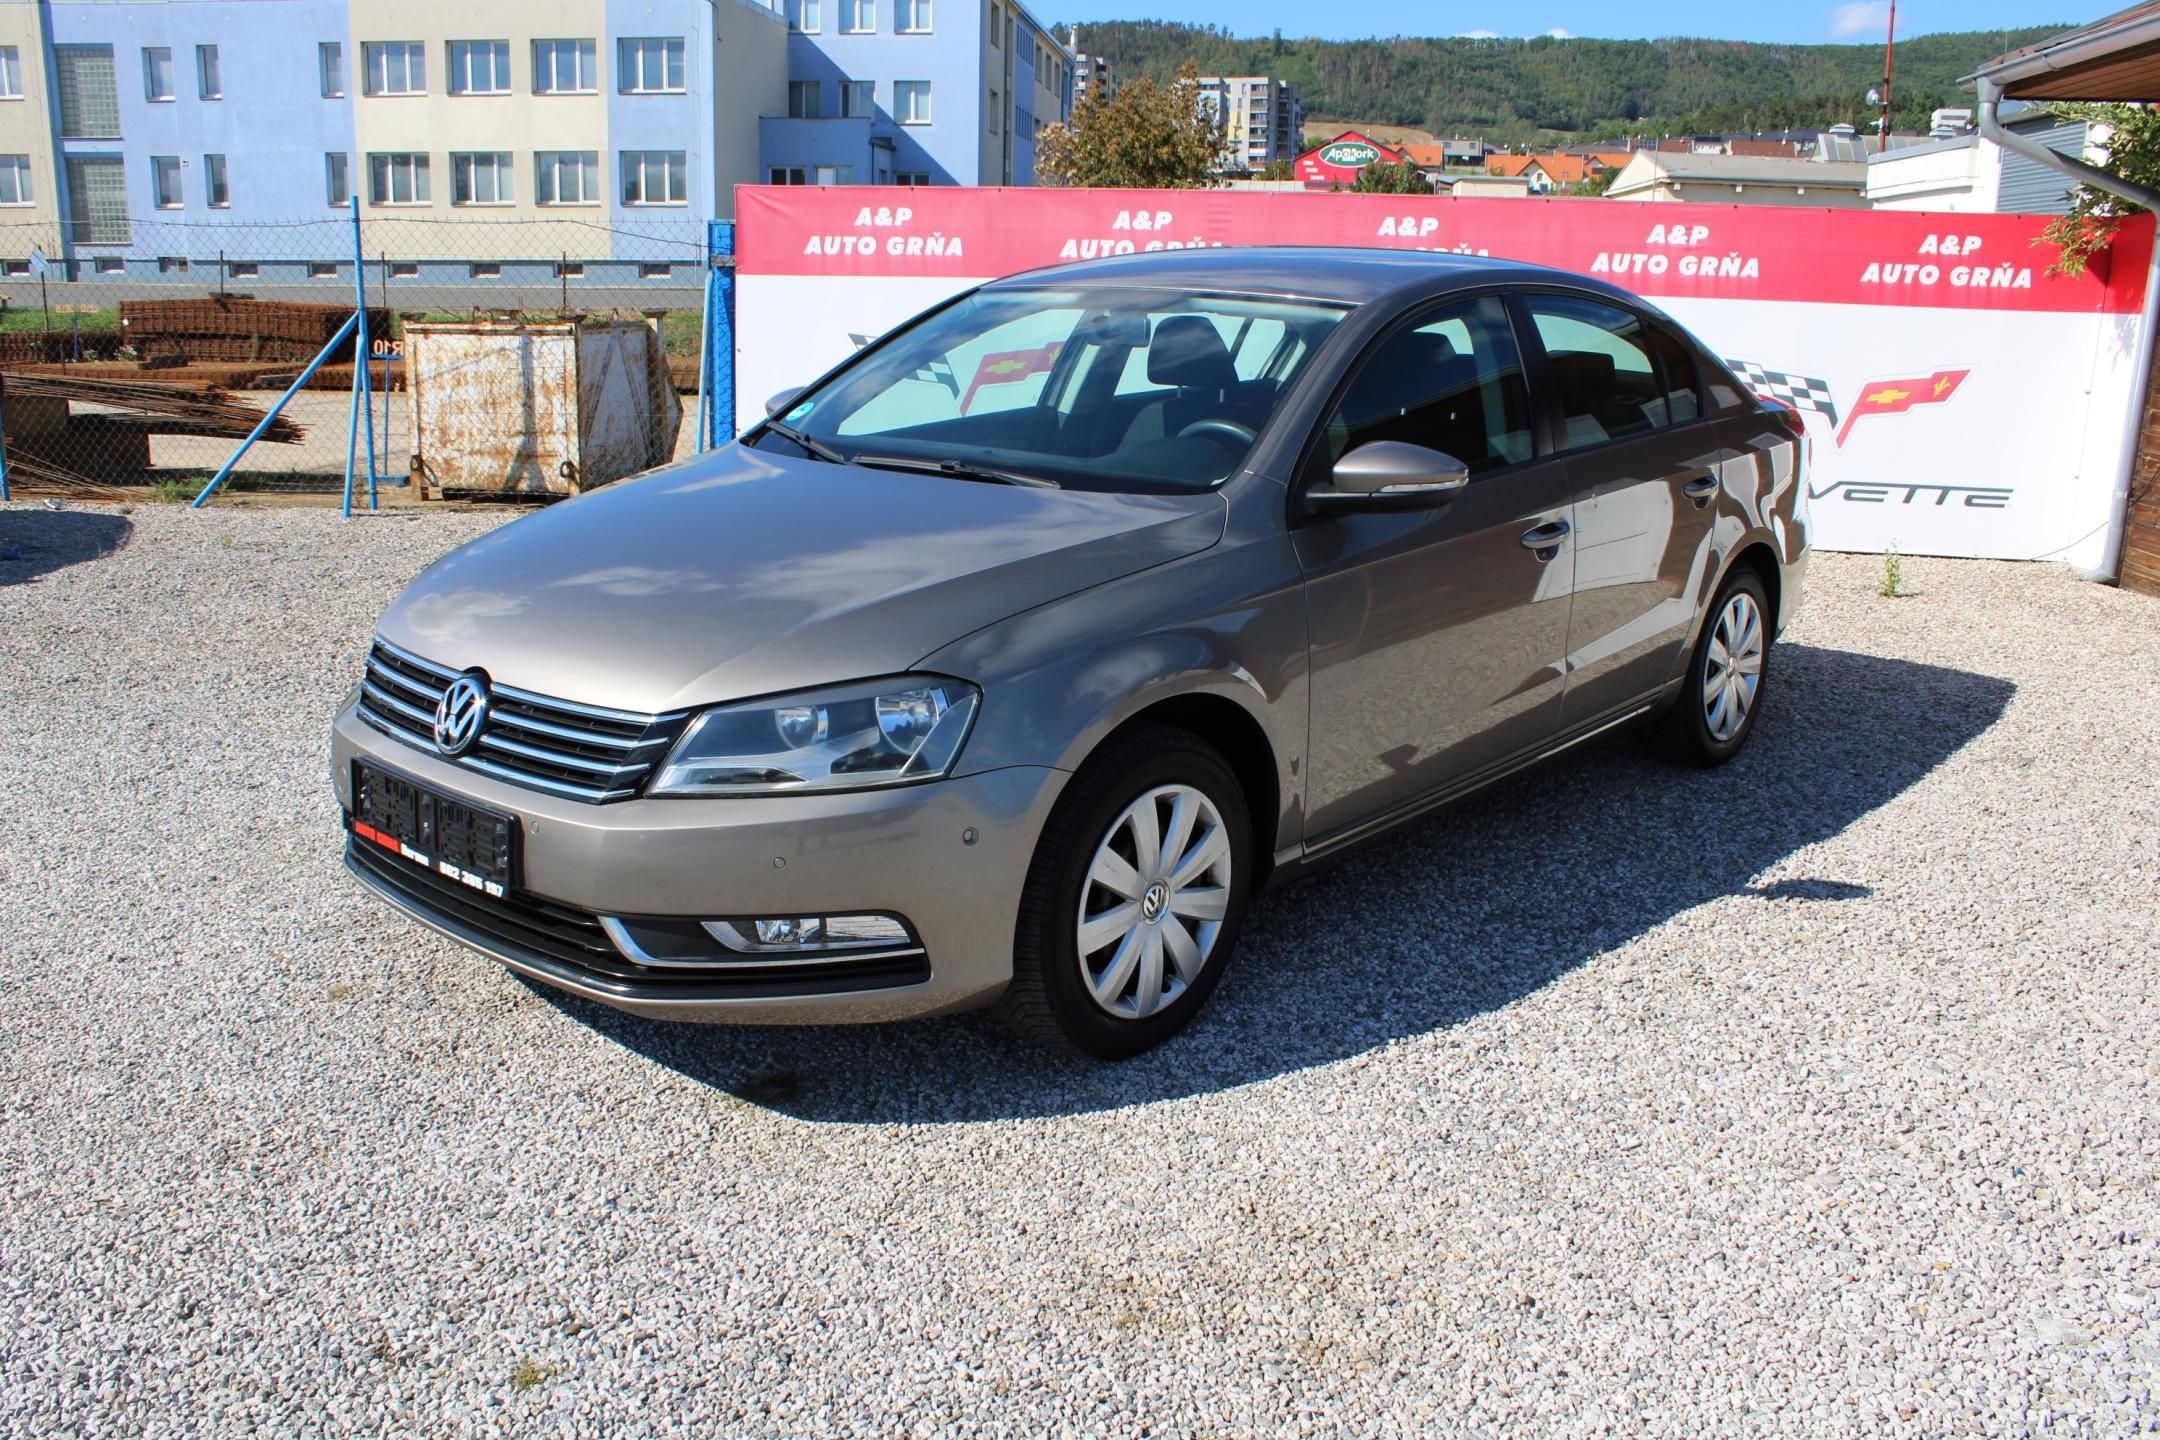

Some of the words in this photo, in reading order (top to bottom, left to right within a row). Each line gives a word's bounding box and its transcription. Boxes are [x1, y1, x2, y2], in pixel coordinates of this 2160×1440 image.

[854, 207, 913, 226] A&P
[1112, 210, 1173, 230] A&P
[1377, 216, 1439, 237] A&P
[803, 236, 877, 255] AUTO
[886, 232, 963, 256] GRŇA
[1646, 224, 1709, 245] A&P
[1918, 234, 1982, 256] A&P
[1059, 239, 1135, 259] AUTO
[1590, 252, 1668, 274] AUTO
[1678, 251, 1759, 277] GRŇA
[1860, 263, 1940, 285] AUTO
[1950, 262, 2032, 288] GRŇA
[1808, 480, 2014, 508] VETTE
